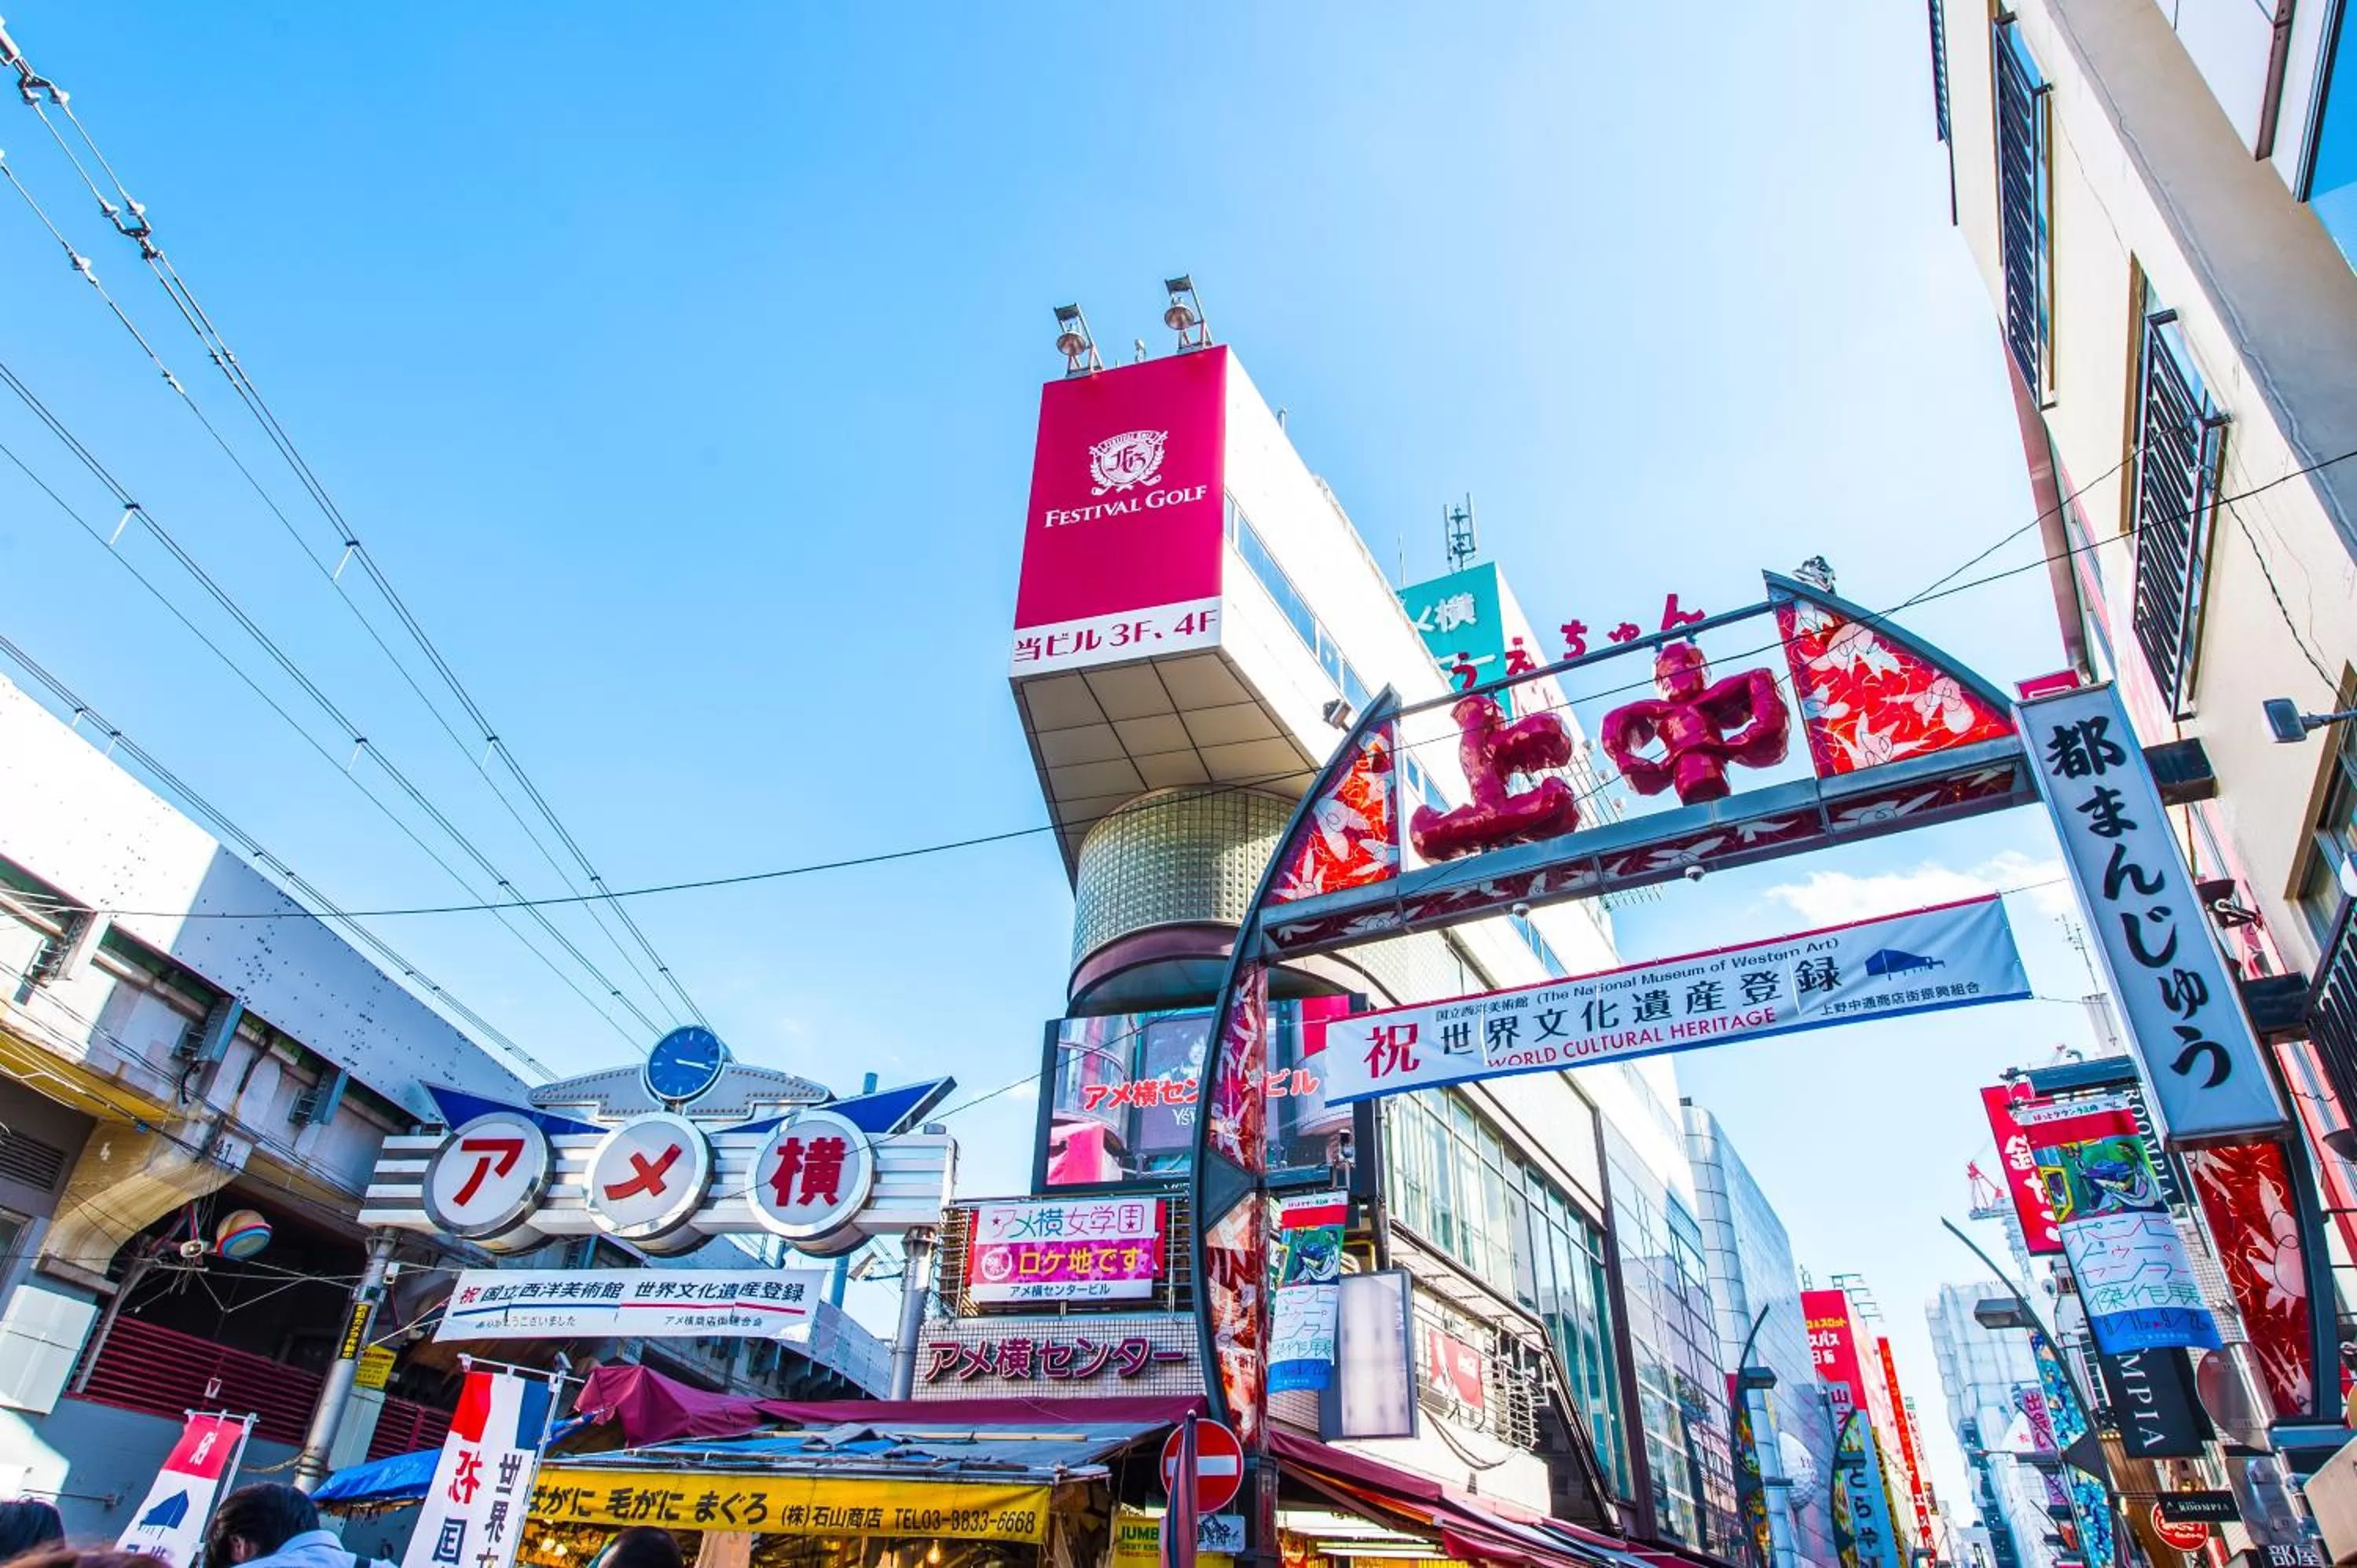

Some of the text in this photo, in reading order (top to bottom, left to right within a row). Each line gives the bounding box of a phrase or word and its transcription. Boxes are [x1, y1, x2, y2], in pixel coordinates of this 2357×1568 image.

[1015, 629, 1102, 662] 当ビル
[2047, 716, 2231, 1089] 都まんじゅう
[1436, 996, 1529, 1022] 国立西洋美術館
[1574, 975, 1637, 998] National
[1641, 965, 1705, 987] Museum
[1710, 958, 1727, 973] of
[1731, 947, 1801, 969] Western
[1820, 981, 1980, 1017] 上野中通商店街振興組合
[1364, 956, 1843, 1079] 祝 世界文化遺産登録
[1487, 1006, 1776, 1068] WORLD CULTURAL HERITAGE
[452, 1136, 847, 1208] アメ横
[991, 1203, 1145, 1239] アメ横女学園
[1018, 1247, 1144, 1274] ロケ地です
[634, 1280, 806, 1302] 世界文化遺産登録
[1010, 1283, 1110, 1297] アメ横センタービル
[925, 1337, 1188, 1383] アメ横センター
[604, 1487, 686, 1521] 毛がに
[694, 1491, 768, 1526] まぐろ
